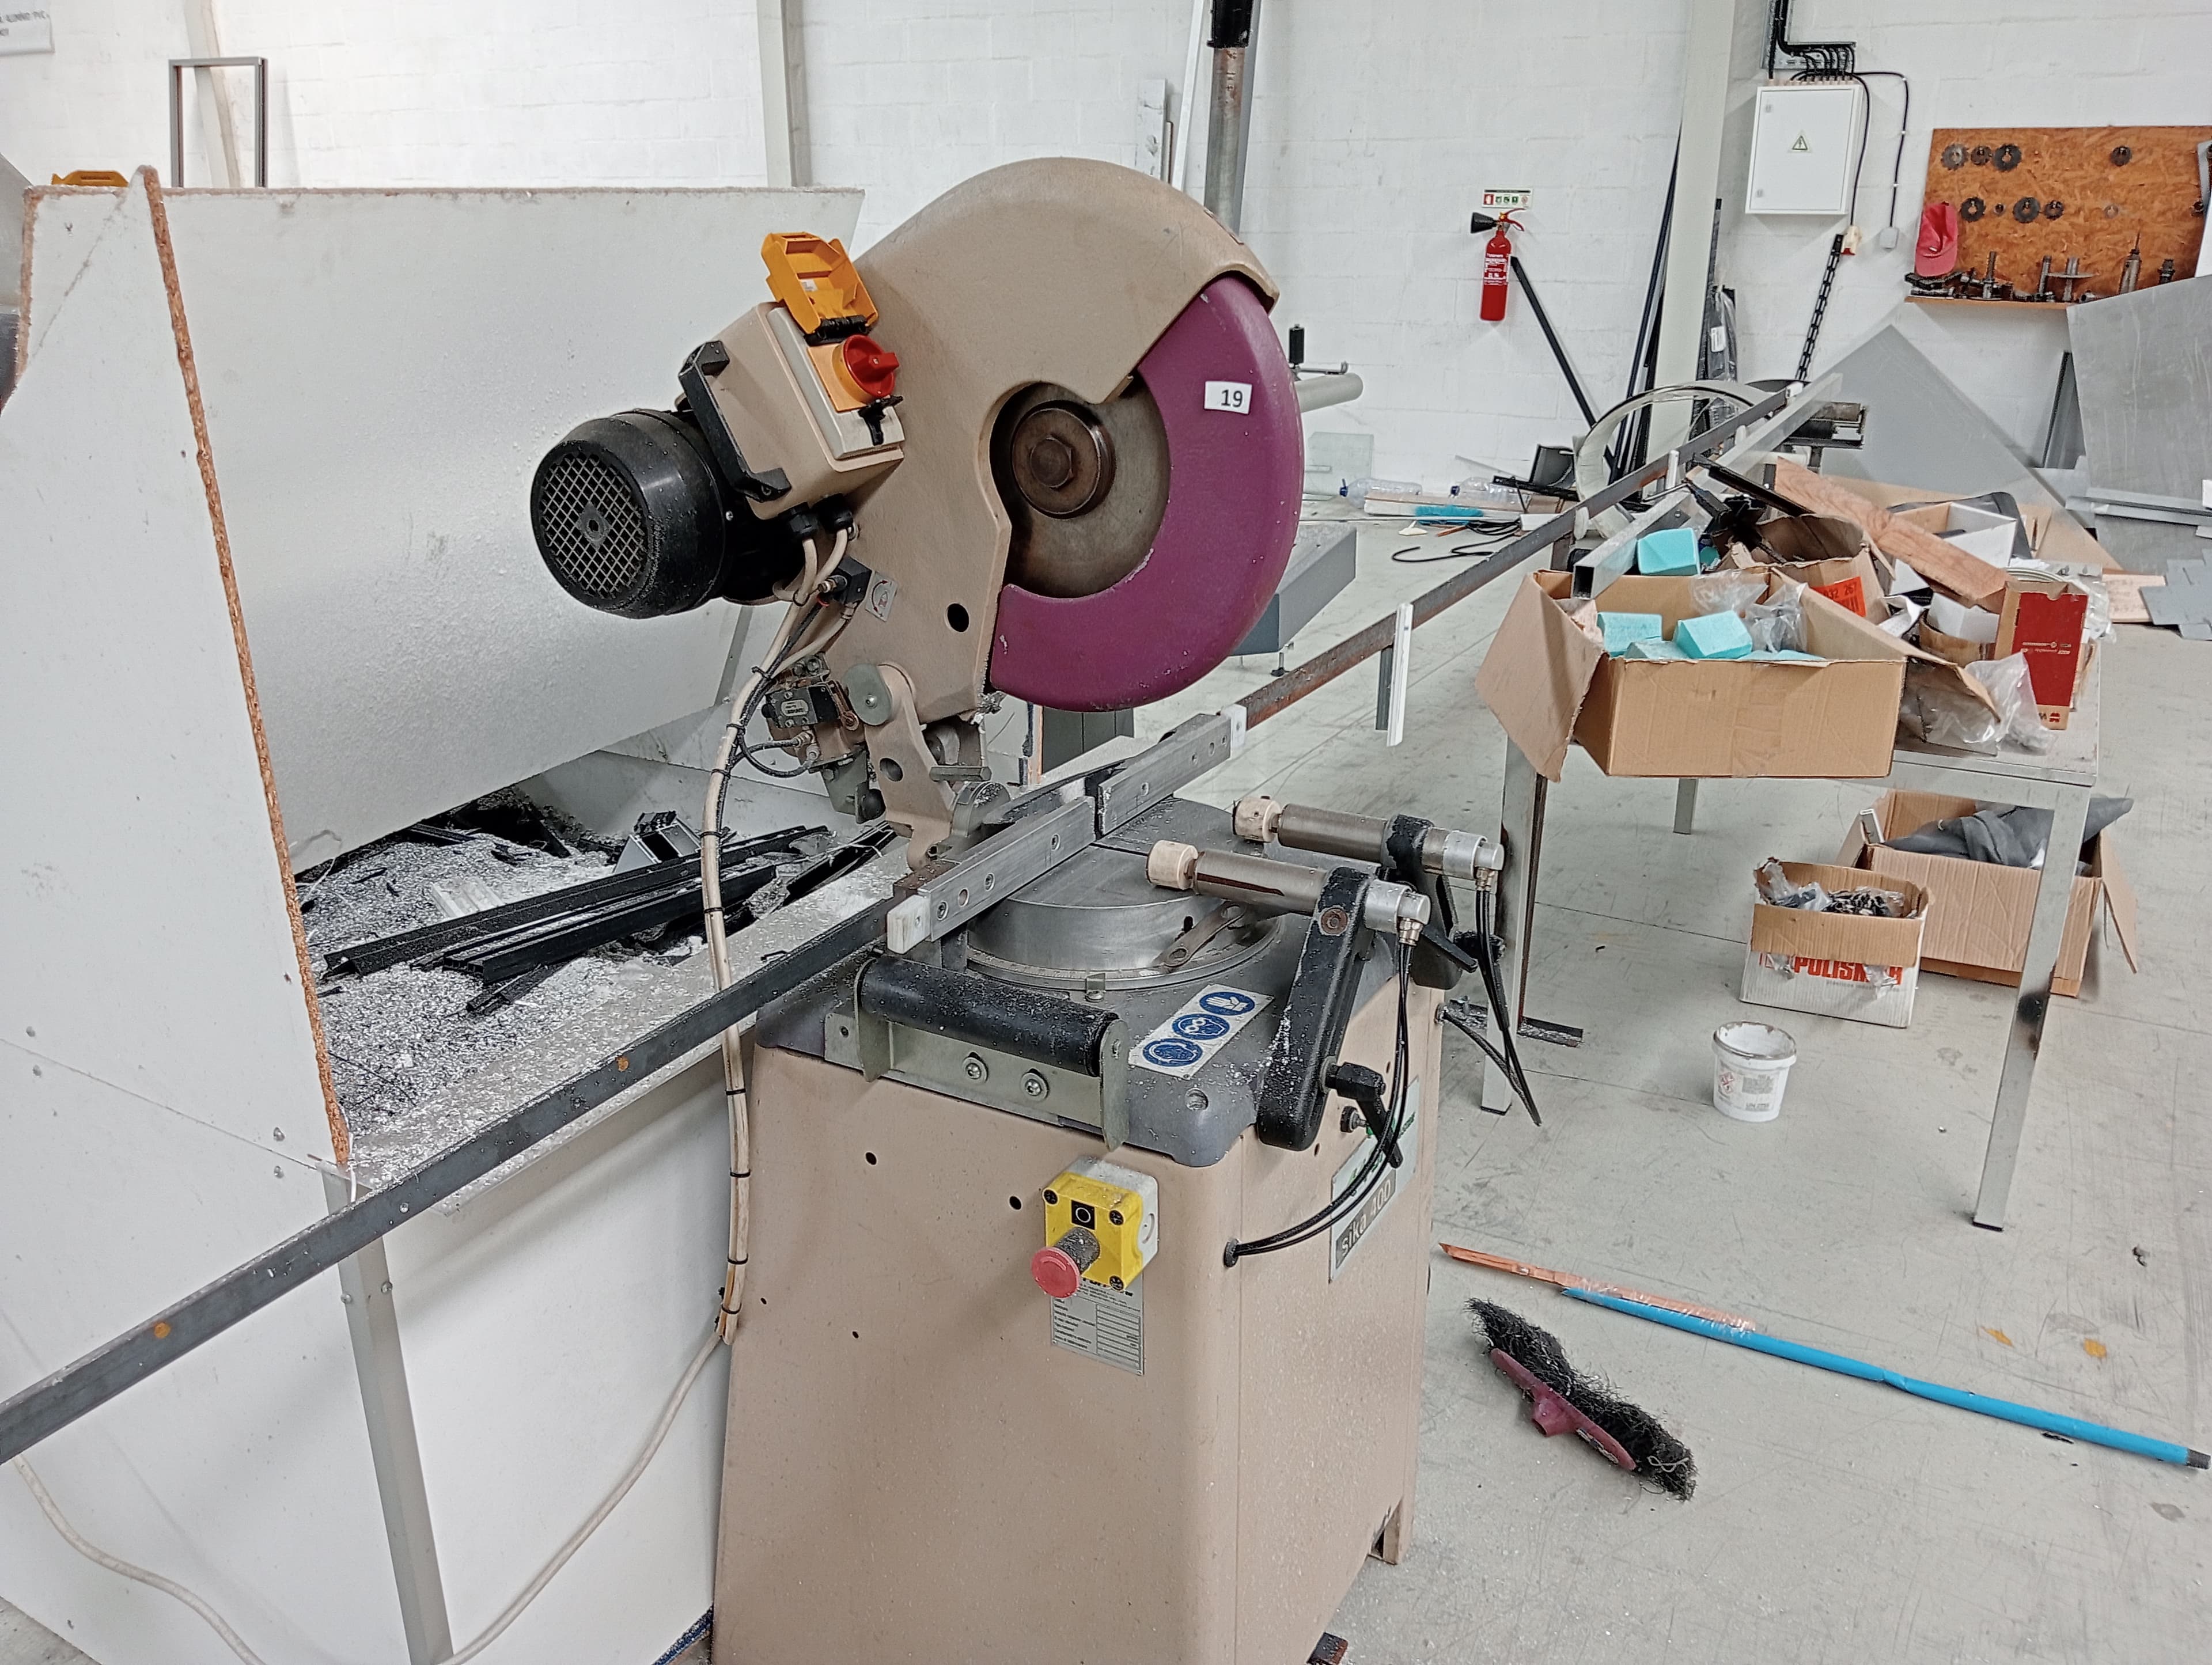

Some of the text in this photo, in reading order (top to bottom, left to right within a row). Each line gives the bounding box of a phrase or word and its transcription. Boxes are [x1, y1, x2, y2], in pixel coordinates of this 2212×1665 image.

[1221, 389, 1243, 408] 19
[1341, 1179, 1391, 1257] sika 400
